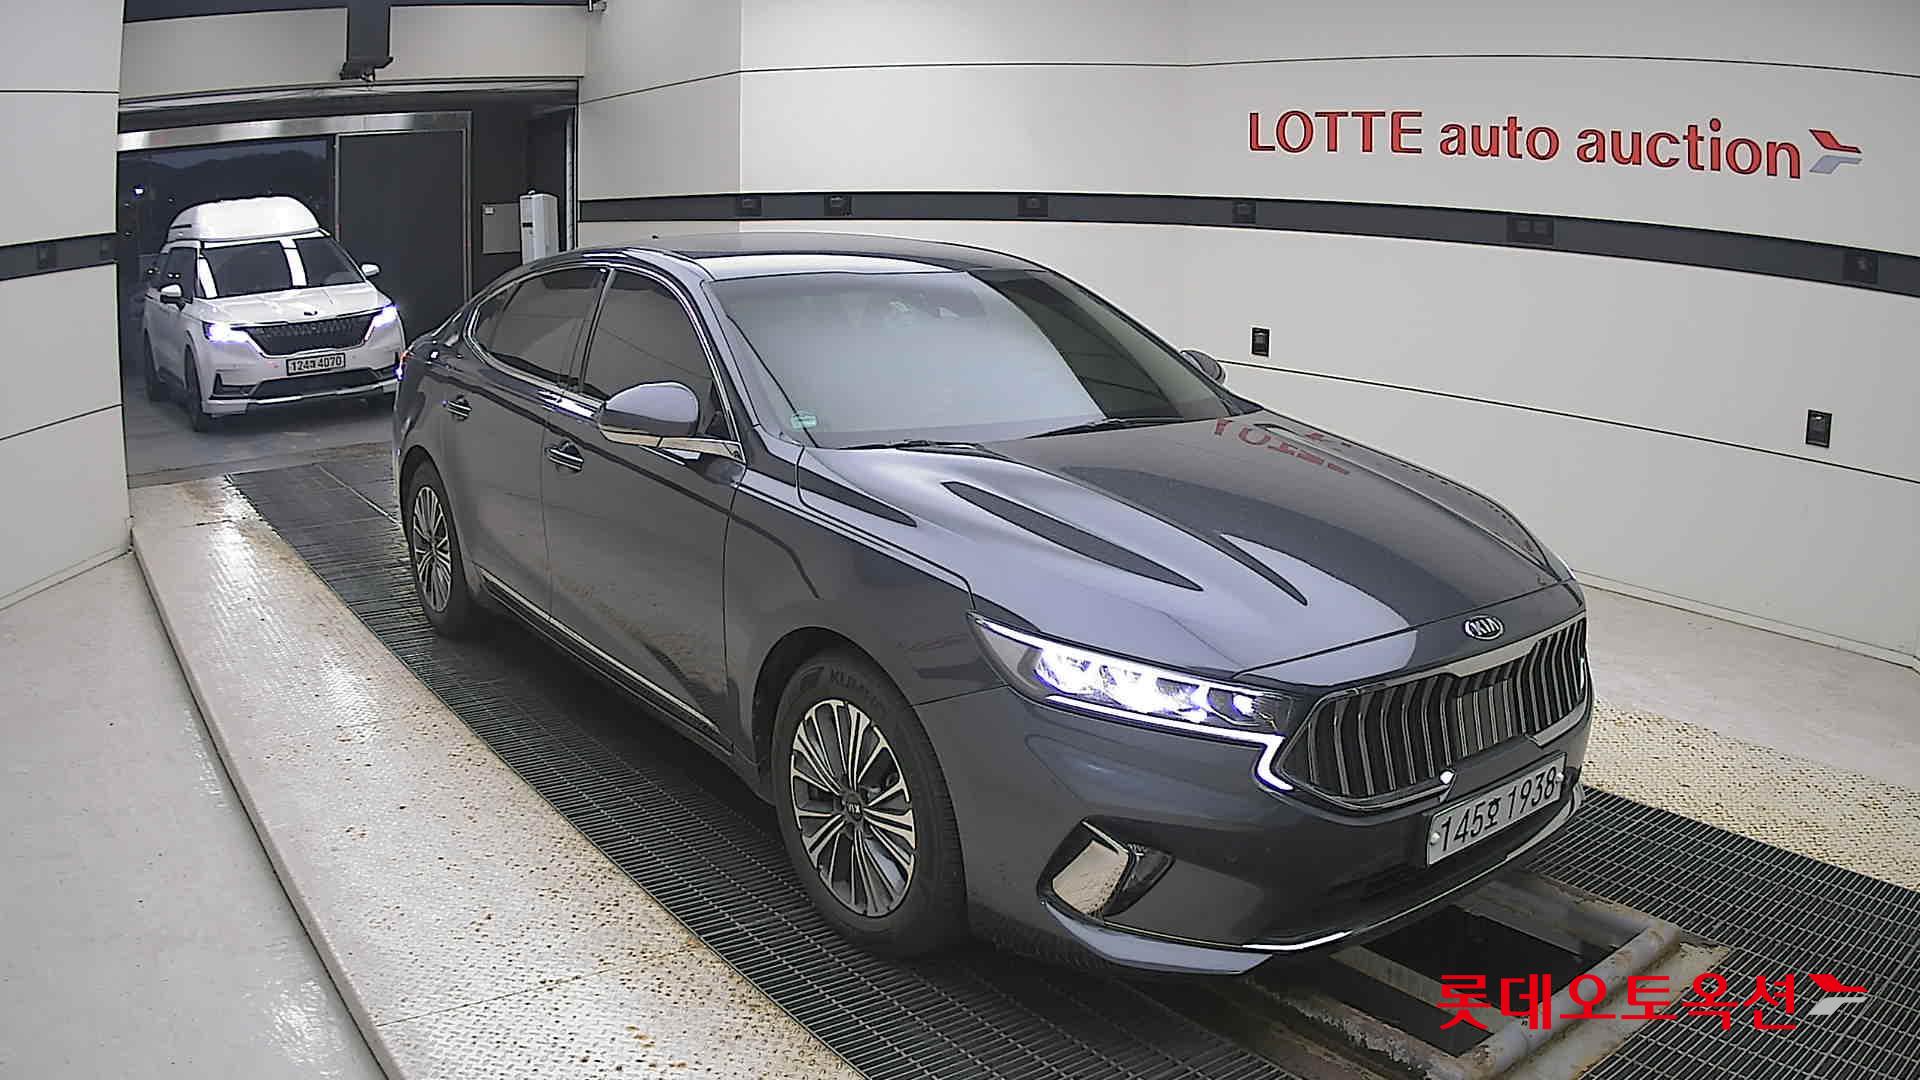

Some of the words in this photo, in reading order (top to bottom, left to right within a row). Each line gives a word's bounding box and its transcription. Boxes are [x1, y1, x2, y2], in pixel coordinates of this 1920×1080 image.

[1249, 110, 1423, 154] LOTTE
[1439, 115, 1561, 161] auto
[1576, 117, 1801, 179] auction
[1469, 617, 1500, 636] KIA
[1508, 766, 1559, 820] 1938
